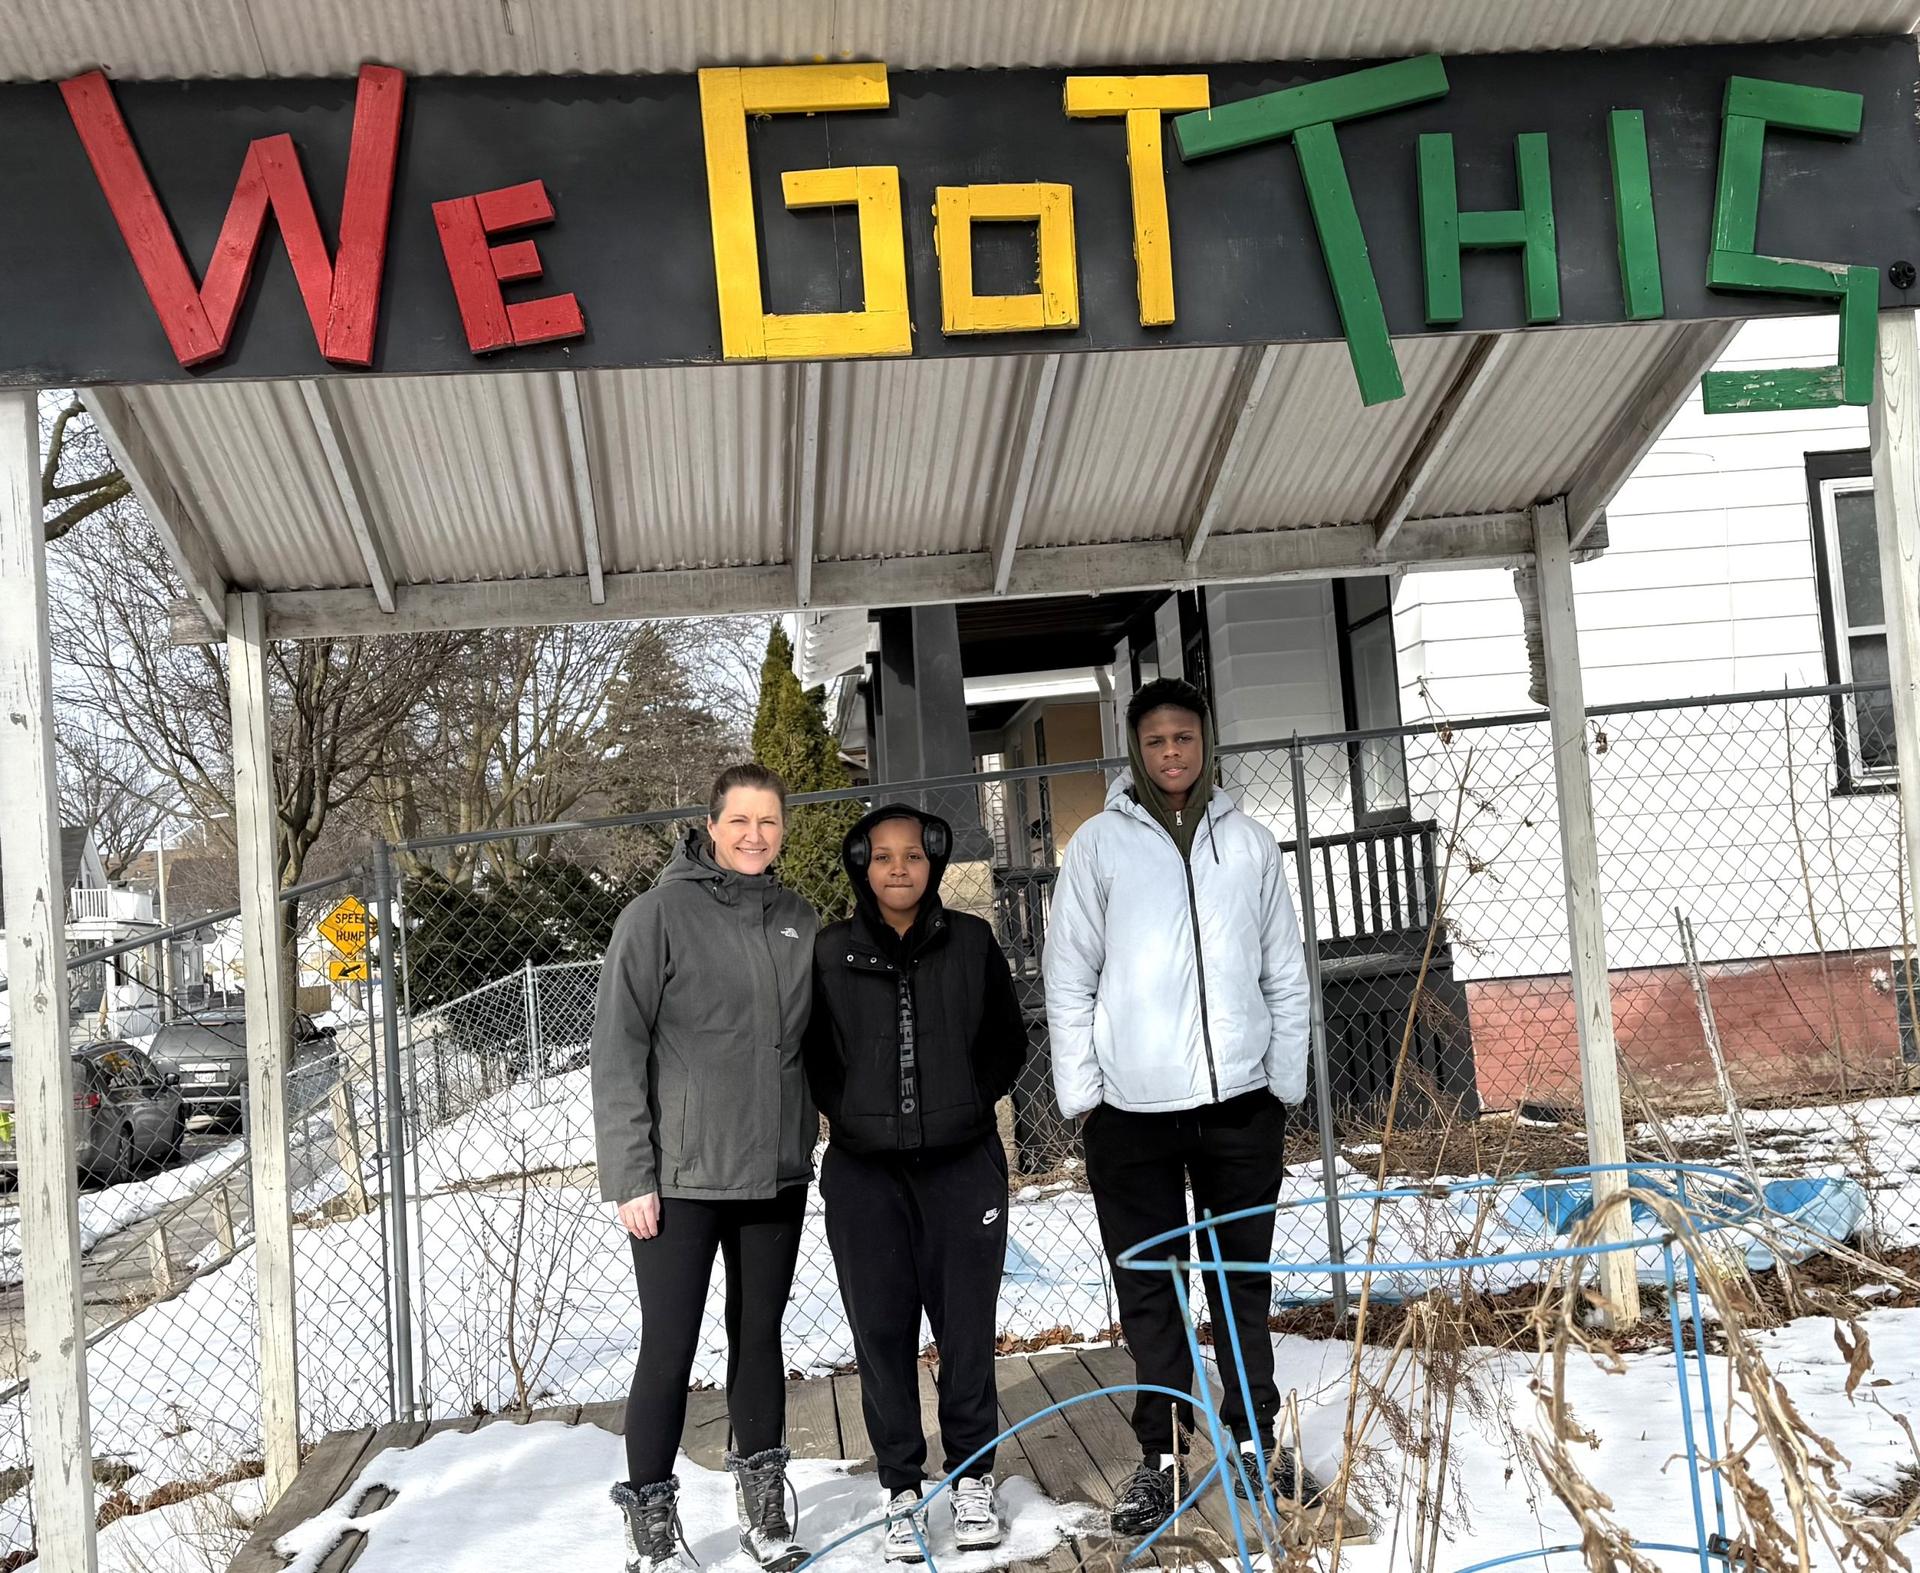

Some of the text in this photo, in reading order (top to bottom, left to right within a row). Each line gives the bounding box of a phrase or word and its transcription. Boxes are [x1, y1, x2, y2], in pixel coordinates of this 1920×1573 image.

[57, 53, 1880, 415] WE GOT THIS
[336, 930, 365, 941] HUMP
